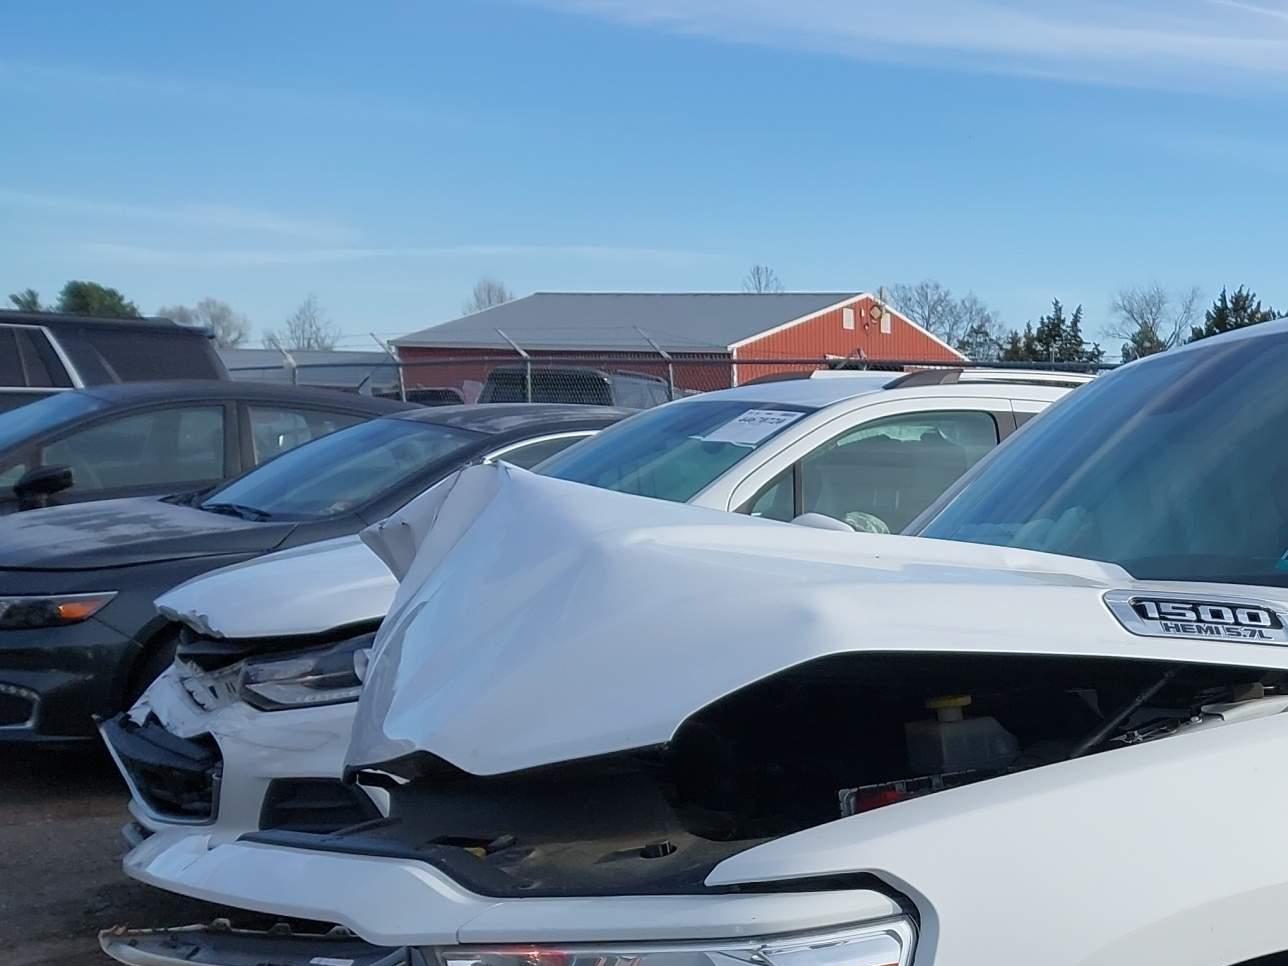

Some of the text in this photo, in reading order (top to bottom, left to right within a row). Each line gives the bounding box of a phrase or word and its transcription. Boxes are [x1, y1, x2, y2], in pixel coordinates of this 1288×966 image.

[1132, 600, 1272, 627] 1500
[1161, 622, 1275, 640] HEMI 5.7L
